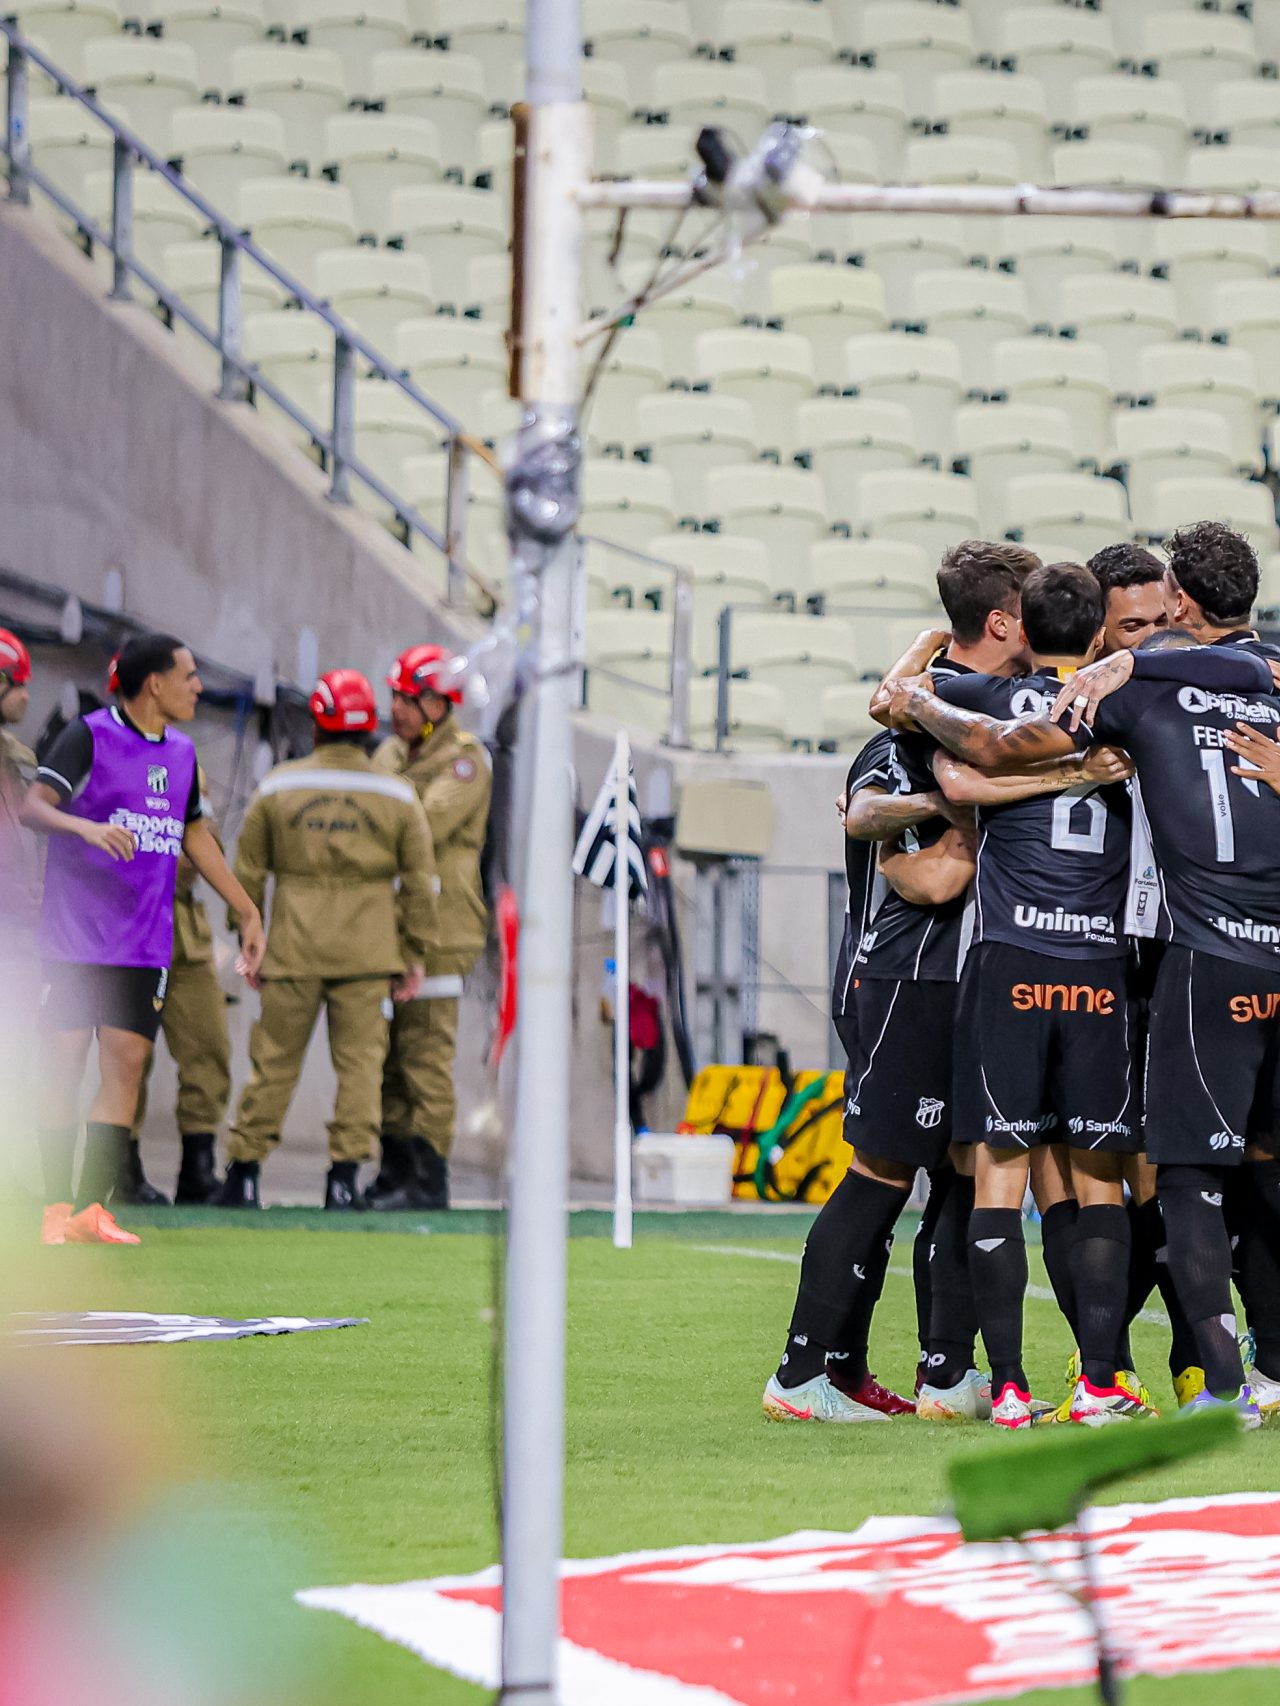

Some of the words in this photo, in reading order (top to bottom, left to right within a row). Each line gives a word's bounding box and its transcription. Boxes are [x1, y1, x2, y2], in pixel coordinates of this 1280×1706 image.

[1206, 694, 1280, 723] Pinheiro
[1226, 711, 1234, 719] O
[1218, 793, 1227, 818] voke
